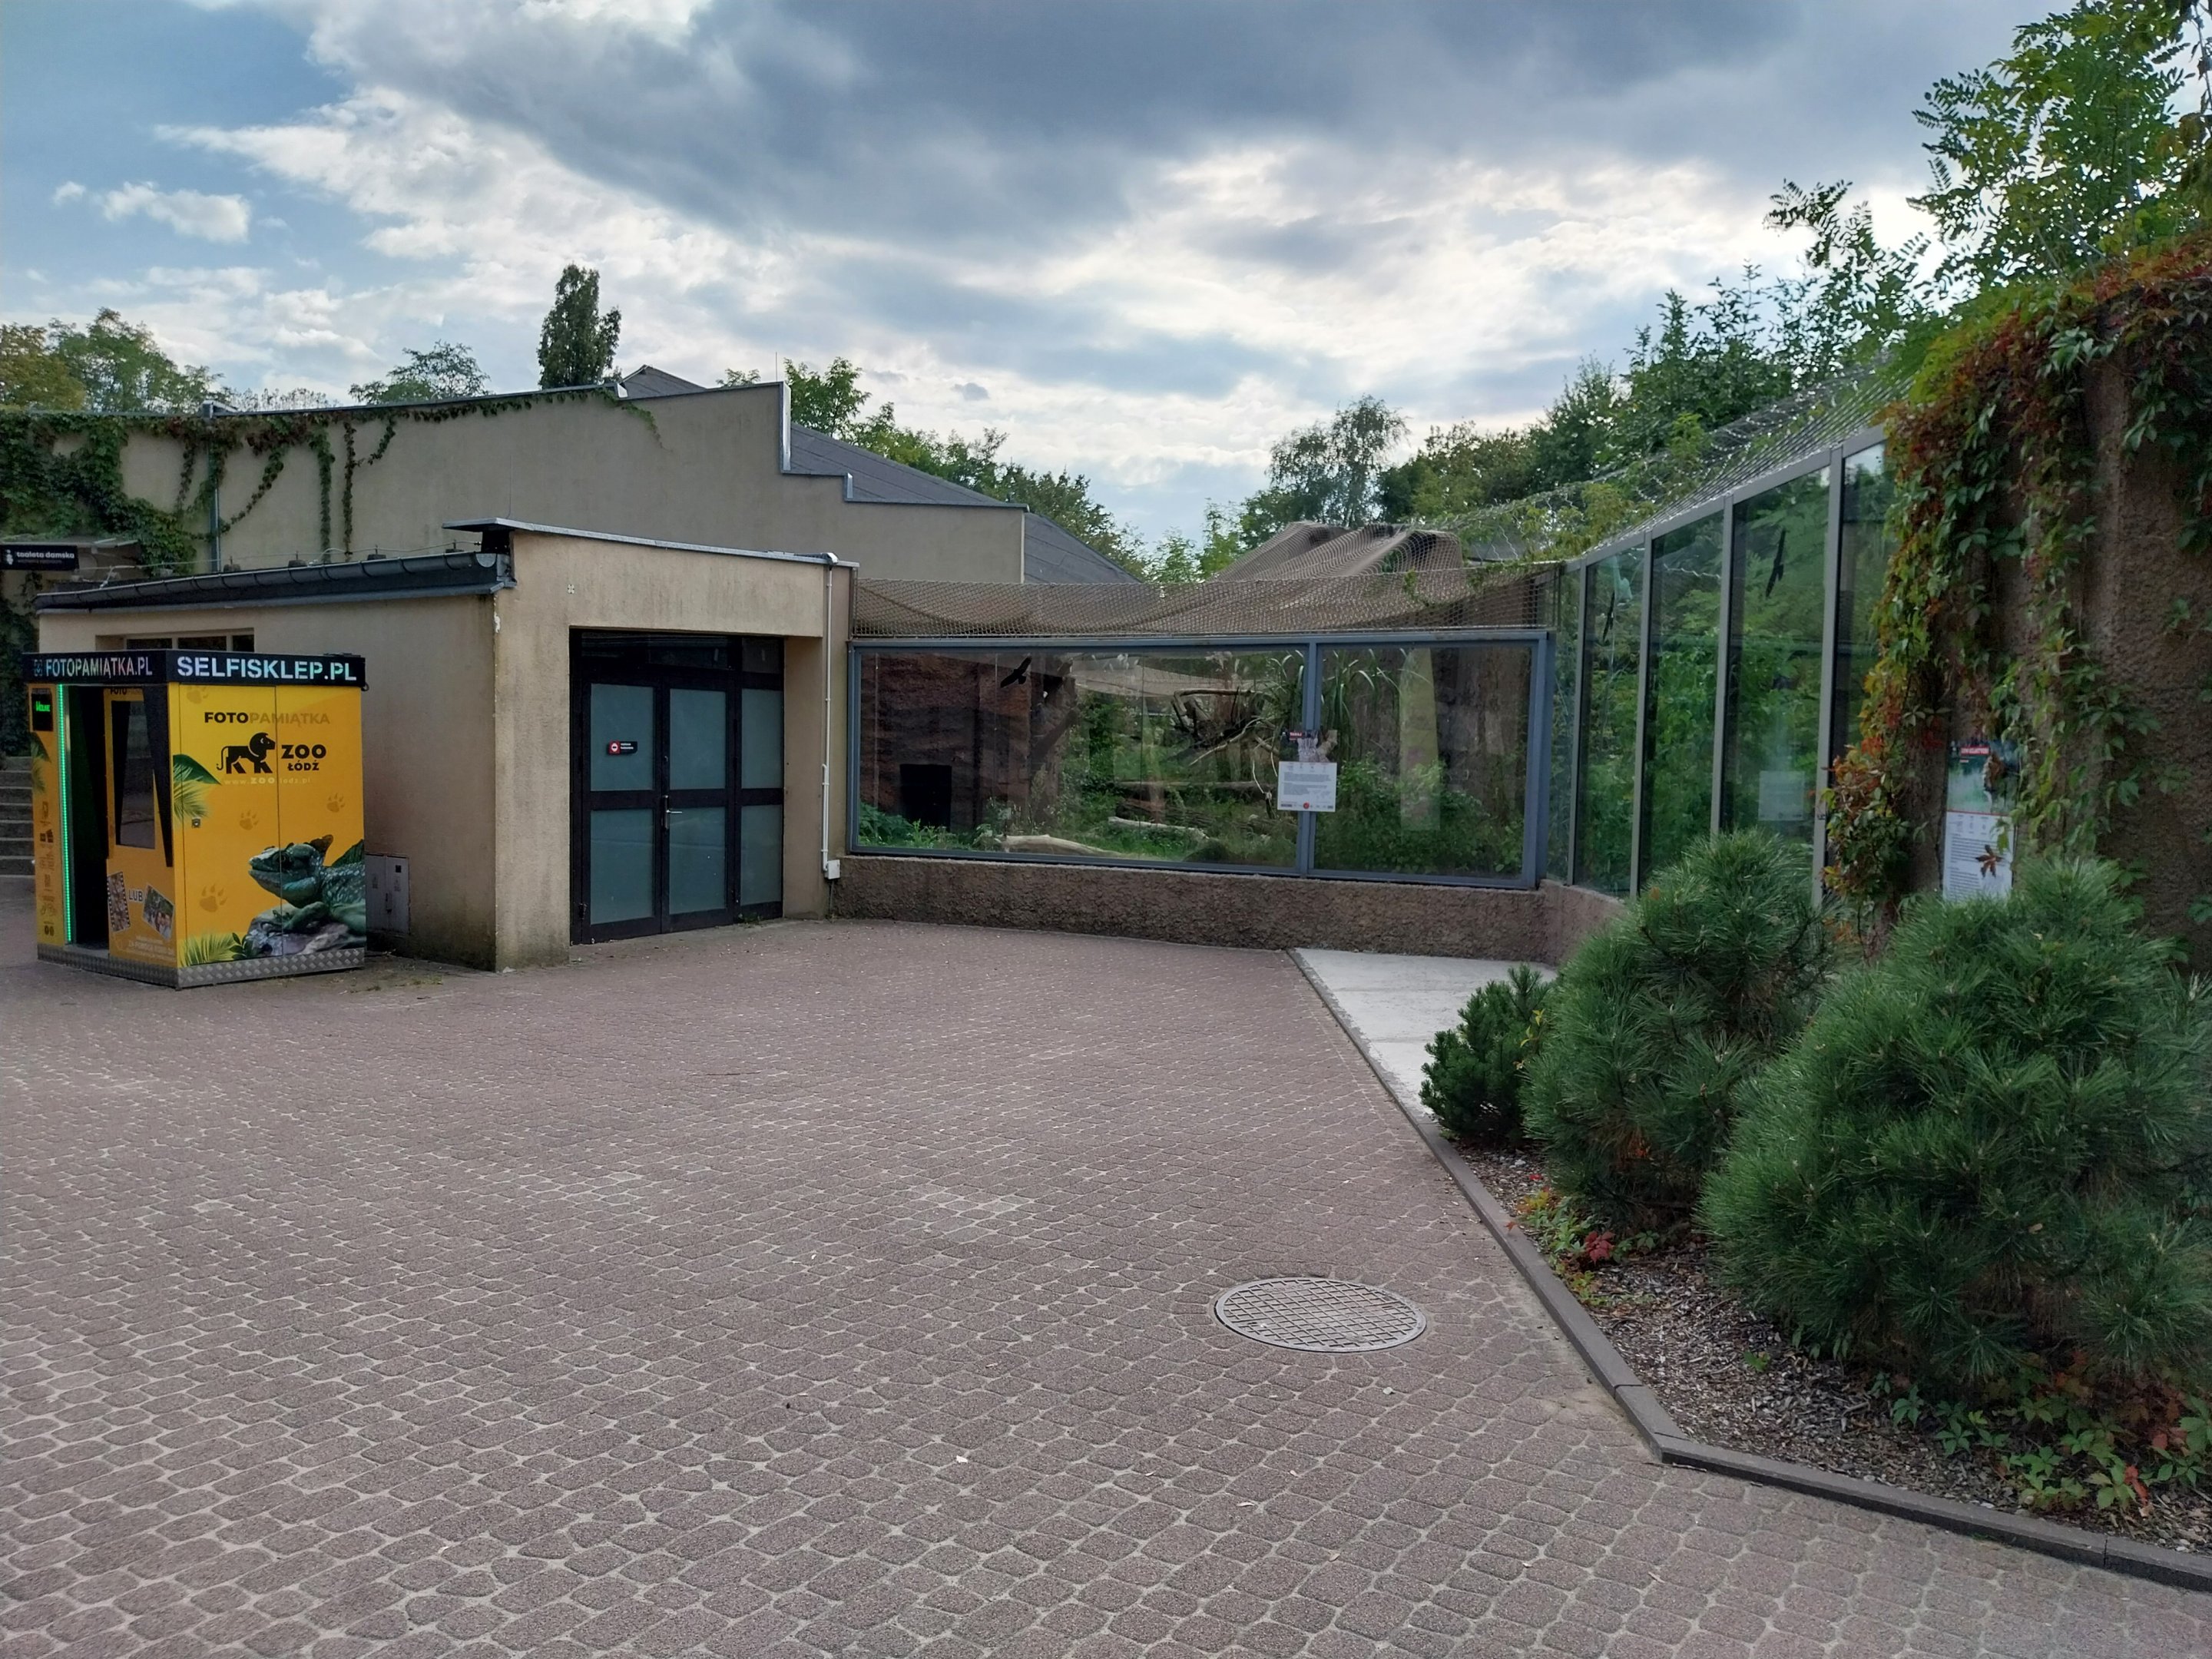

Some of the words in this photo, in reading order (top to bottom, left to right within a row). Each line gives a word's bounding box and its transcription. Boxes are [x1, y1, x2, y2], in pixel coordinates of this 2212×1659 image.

[46, 656, 153, 678] FOTOPAMIĄTKA.PL
[177, 656, 357, 681] SELFISKLEP.PL
[204, 712, 330, 727] FOTOPAMIĄTKA
[281, 743, 327, 760] ZOO
[287, 760, 320, 771] ŁÓDŹ
[128, 889, 144, 902] LUB
